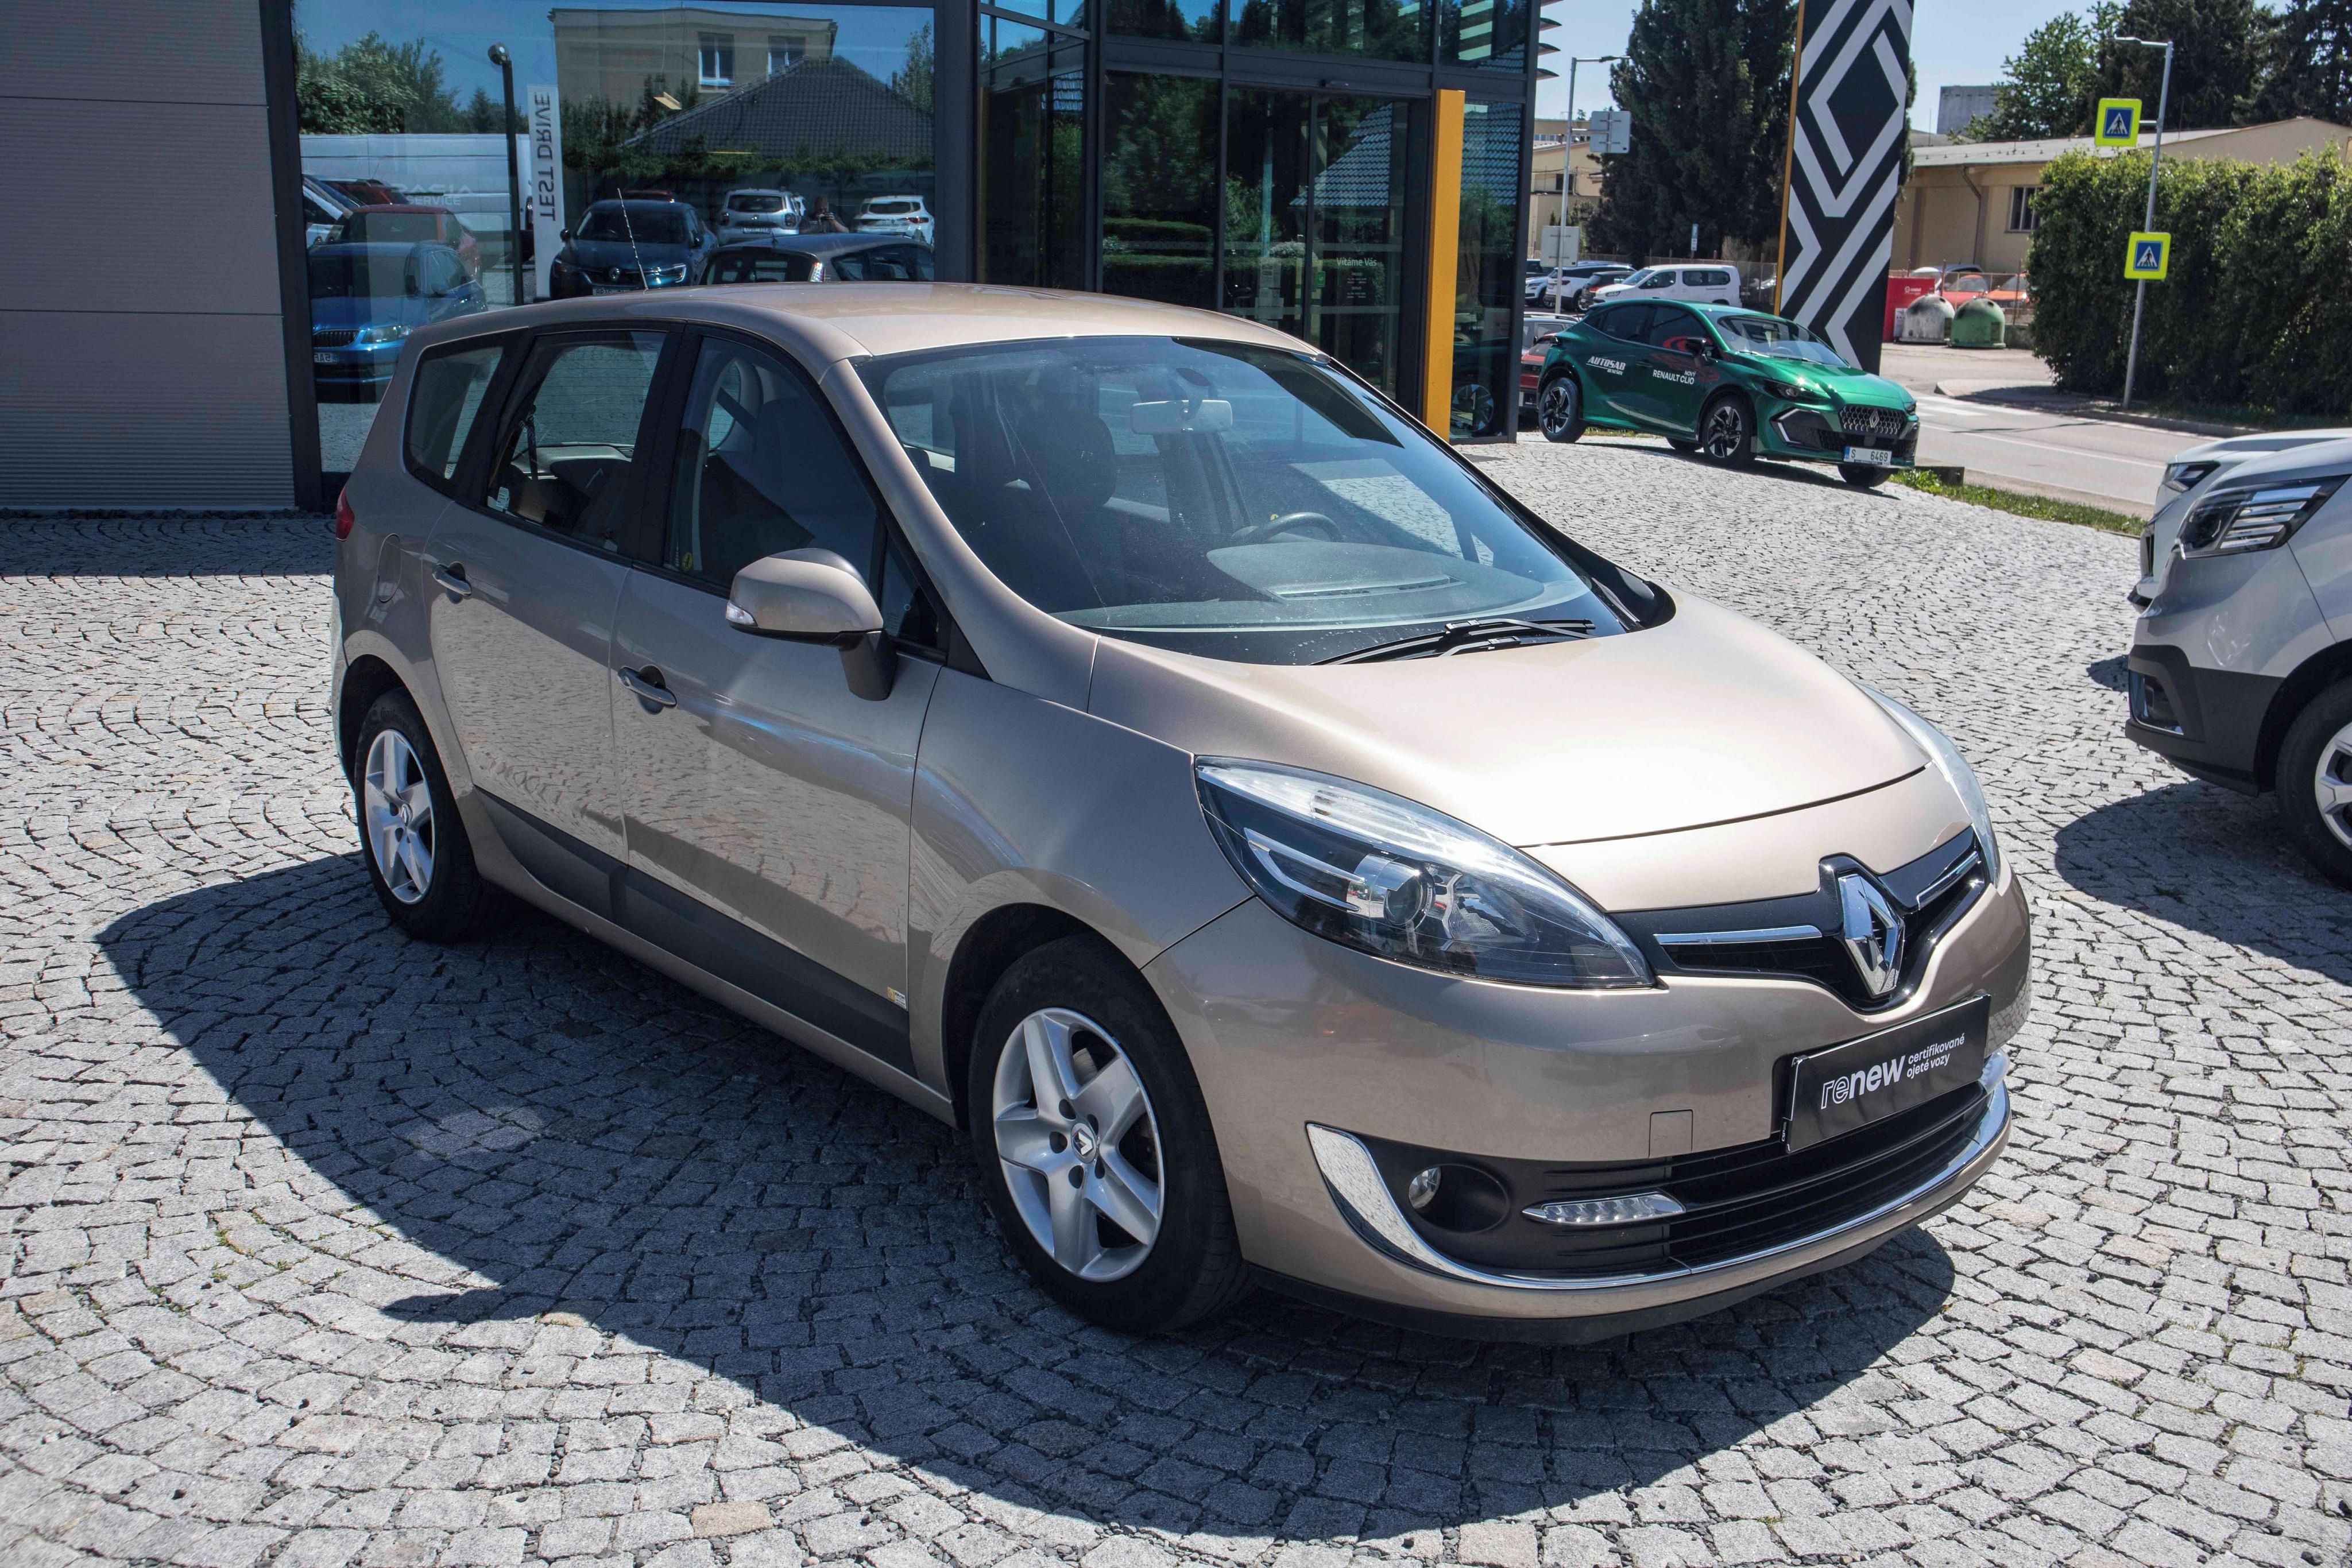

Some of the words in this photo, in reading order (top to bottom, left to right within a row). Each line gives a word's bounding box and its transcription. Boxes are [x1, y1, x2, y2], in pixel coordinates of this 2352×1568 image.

[1336, 257, 1363, 266] Vítáme
[1364, 257, 1378, 266] Vás
[1653, 369, 1681, 382] RENAULT
[1680, 375, 1695, 385] CLIO
[1851, 448, 1856, 458] S
[1870, 451, 1889, 462] 6469
[1908, 1033, 1965, 1064] certifikované
[1906, 1058, 1929, 1079] ojeté
[1930, 1053, 1951, 1069] vozy
[1821, 1055, 1906, 1109] renew
